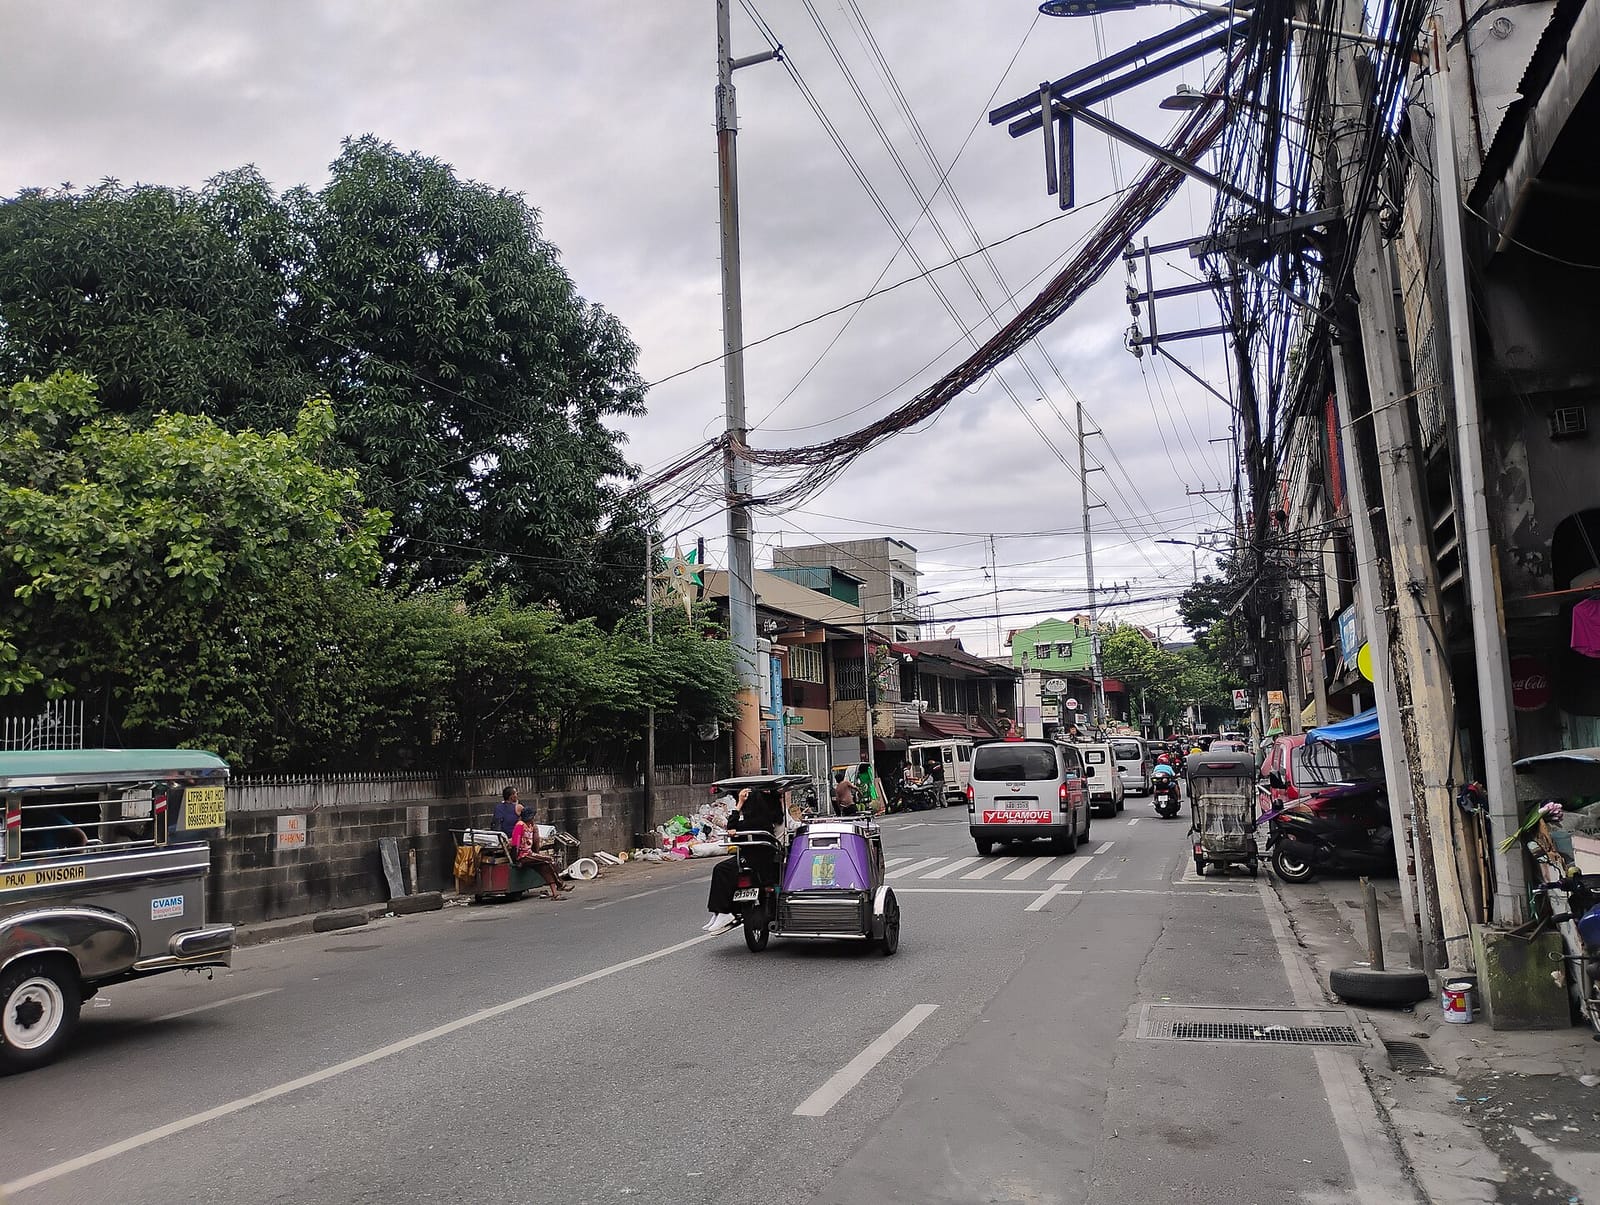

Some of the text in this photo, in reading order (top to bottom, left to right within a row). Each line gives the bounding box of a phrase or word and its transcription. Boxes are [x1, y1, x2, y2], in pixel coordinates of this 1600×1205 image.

[187, 791, 203, 802] LTFRB
[997, 811, 1049, 819] LALAMOVE
[287, 819, 299, 829] NO
[280, 832, 305, 843] PARKING
[5, 866, 84, 886] PAJO DIVISORIA
[153, 897, 182, 908] CVAMS
